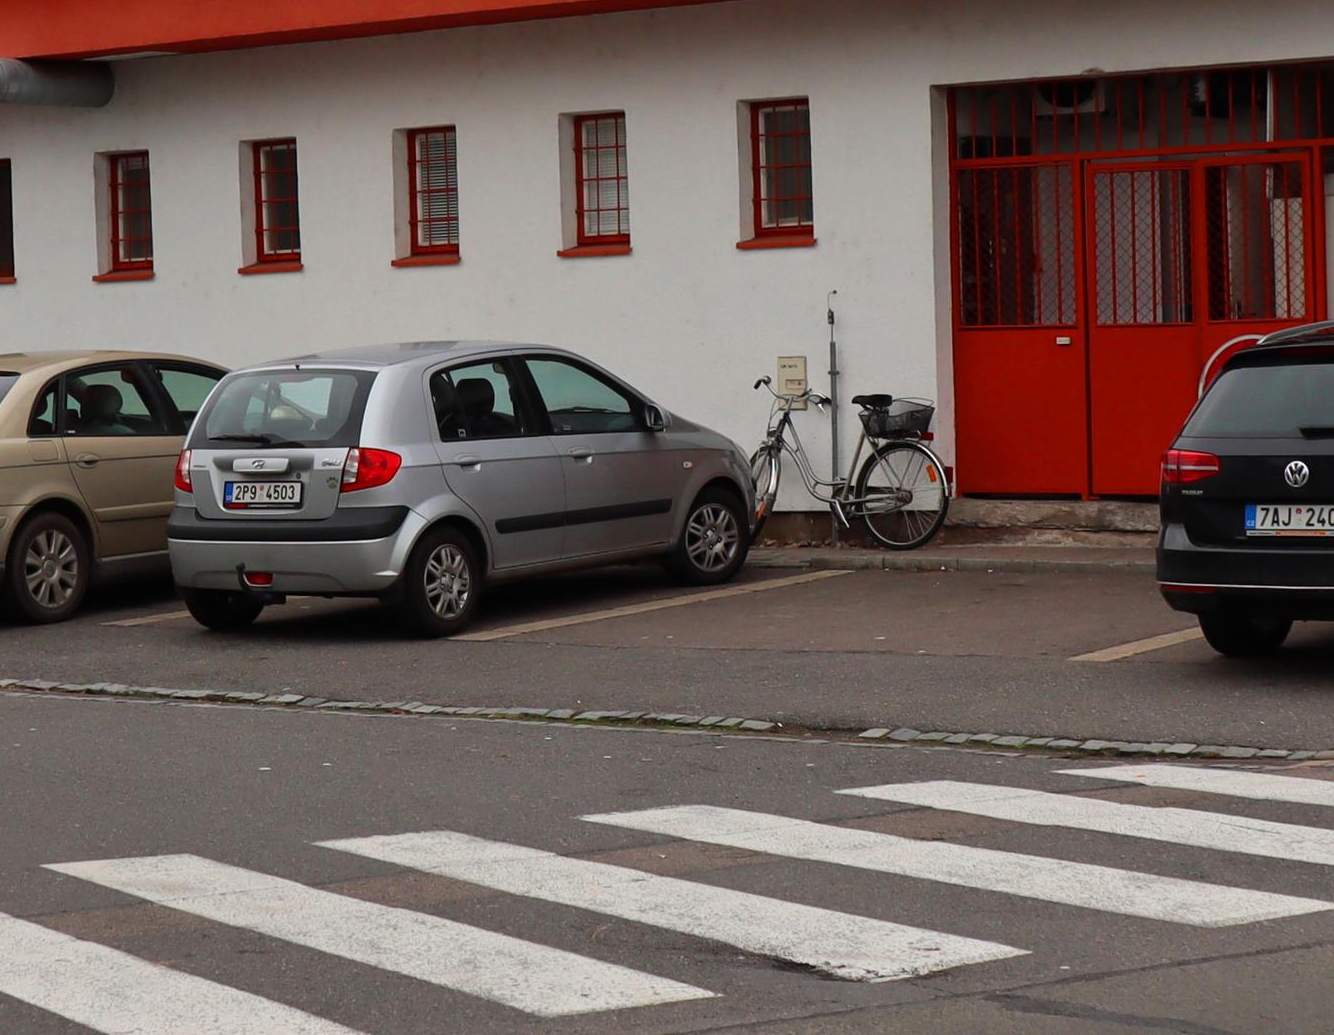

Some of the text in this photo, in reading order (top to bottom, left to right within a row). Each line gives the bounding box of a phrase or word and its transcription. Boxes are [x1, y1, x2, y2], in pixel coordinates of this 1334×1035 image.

[234, 484, 295, 500] 2P9 4503
[1260, 507, 1292, 527] 7AJ
